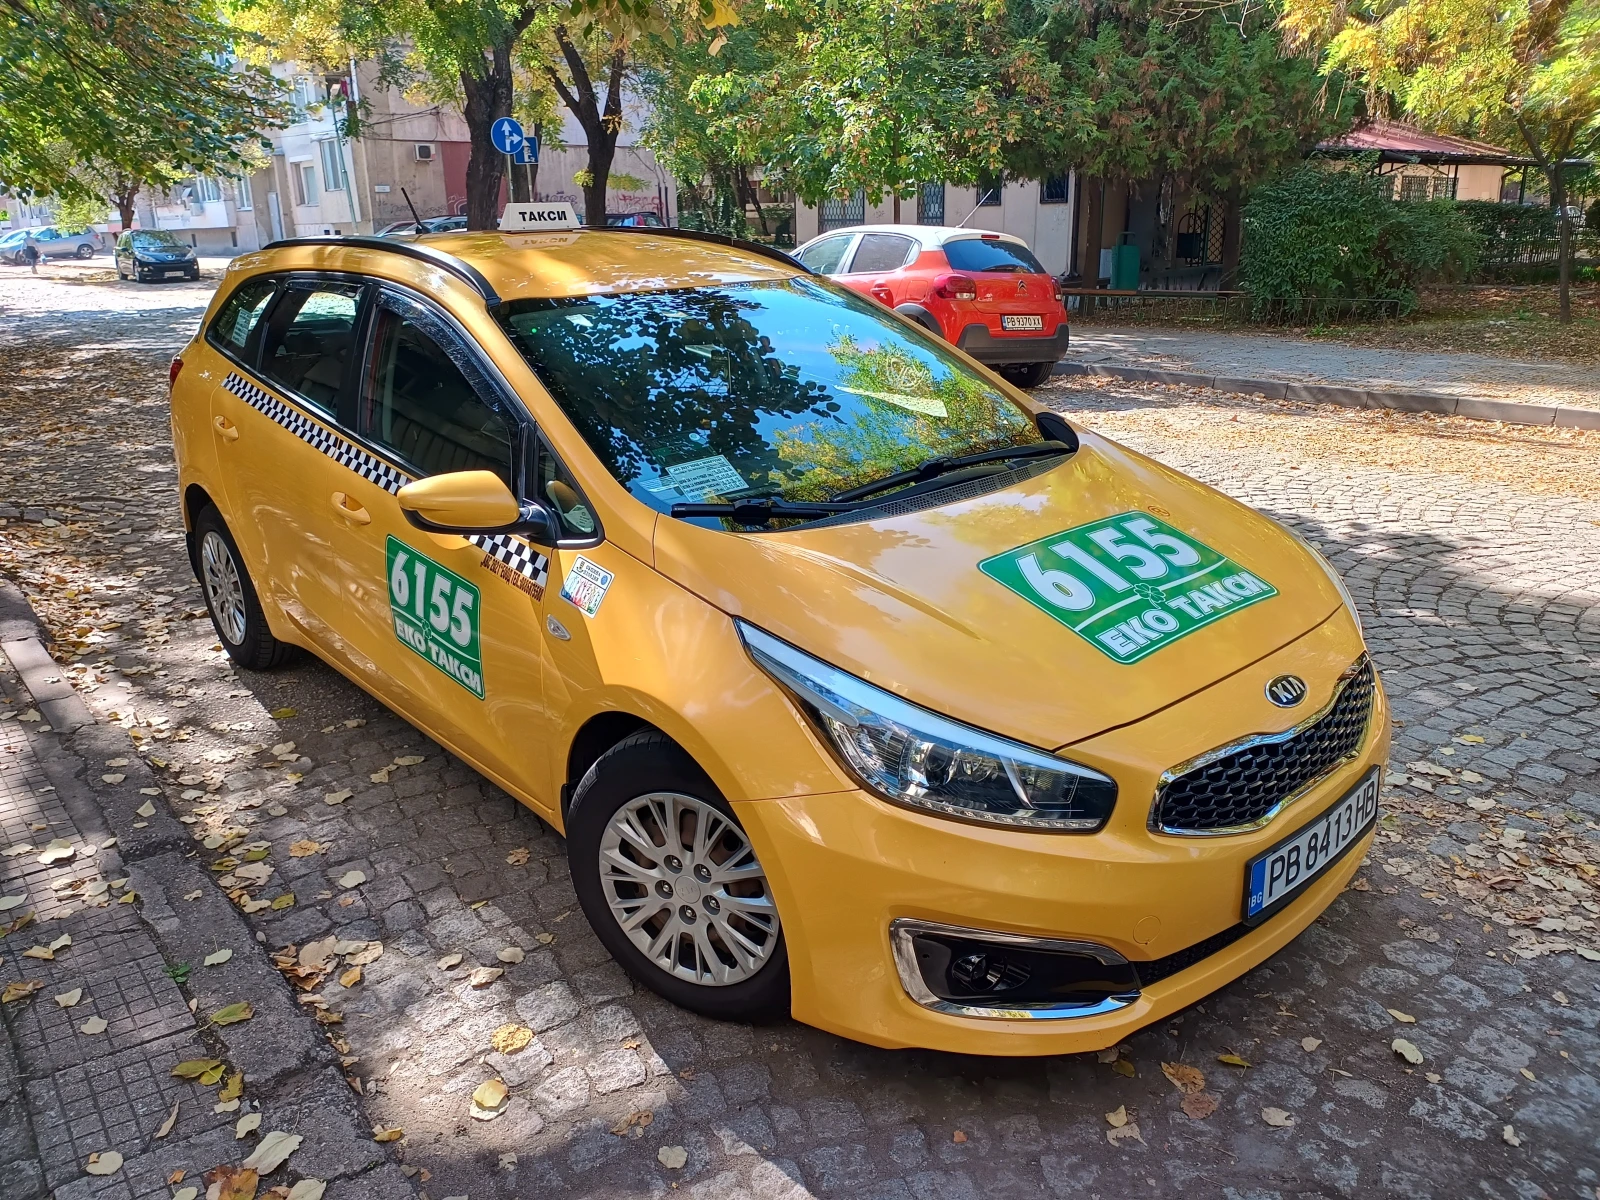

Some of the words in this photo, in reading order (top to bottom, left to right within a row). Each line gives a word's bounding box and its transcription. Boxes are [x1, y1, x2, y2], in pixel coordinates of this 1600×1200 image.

[518, 210, 568, 222] ТАКСИ
[1006, 317, 1016, 327] PB
[1016, 316, 1032, 327] 9370
[391, 550, 475, 647] 6155
[1014, 517, 1202, 612] 6155
[1095, 608, 1179, 658] ЕКО
[1165, 570, 1273, 620] ТАКСИ
[394, 615, 427, 653] ЕКО
[427, 641, 483, 695] ТАКСИ
[1271, 676, 1306, 703] KIA
[1268, 844, 1301, 899] PB
[1305, 803, 1353, 871] 8413
[1354, 780, 1375, 831] HB
[1250, 891, 1263, 908] BG
